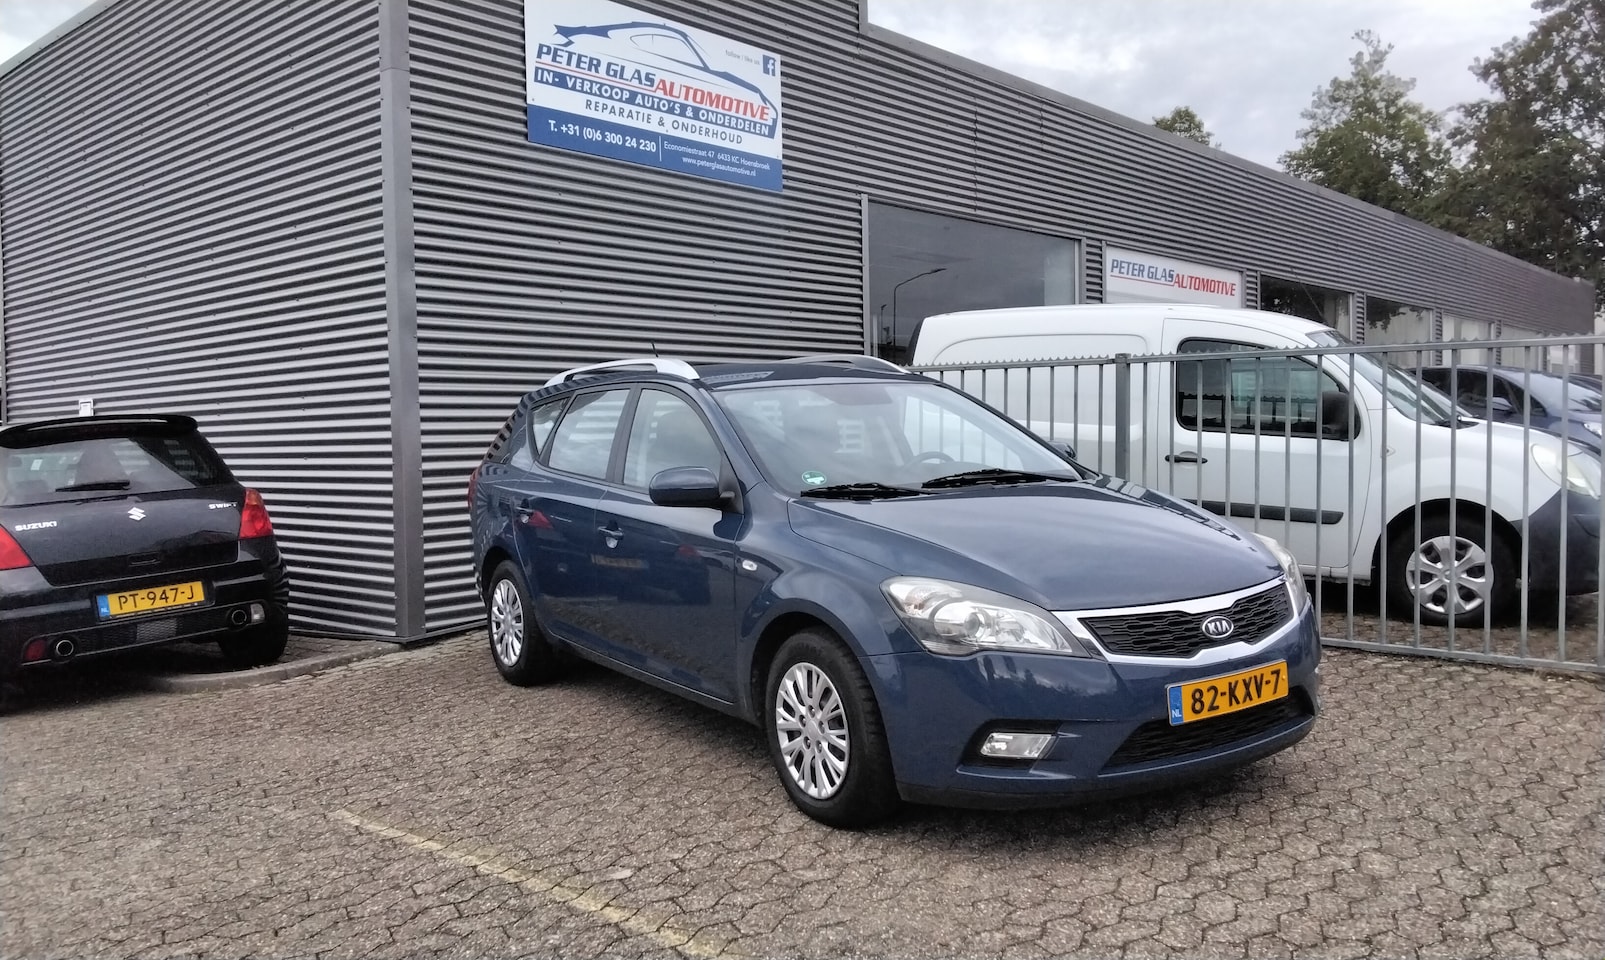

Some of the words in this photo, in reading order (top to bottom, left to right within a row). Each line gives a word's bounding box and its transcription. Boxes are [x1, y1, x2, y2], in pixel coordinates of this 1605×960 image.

[536, 43, 601, 74] PETER
[537, 69, 560, 84] IN-
[566, 76, 630, 101] VERKOOP
[635, 94, 680, 114] AUTO'S
[685, 106, 694, 118] &
[698, 111, 769, 136] ONDERDELEN
[585, 99, 652, 124] REPARATIE
[657, 116, 665, 128] &
[671, 120, 743, 144] ONDERHOUD
[548, 119, 557, 132] T.
[561, 124, 580, 136] +31
[583, 127, 602, 141] (0)6
[604, 132, 623, 145] 300
[625, 136, 637, 148] 24
[639, 140, 656, 152] 230
[664, 141, 707, 157] Economiestraat
[717, 152, 730, 162] 6433
[731, 156, 739, 164] KC
[740, 158, 770, 170] Hoensbroek
[682, 157, 756, 176] www.peterglasautomotive.nl
[1110, 258, 1145, 278] PETER
[15, 521, 57, 531] SUZUKI
[118, 585, 194, 610] PT-947-J
[1207, 620, 1230, 634] KIA
[1190, 668, 1281, 715] 82-KXV-7
[1172, 709, 1182, 718] NL
